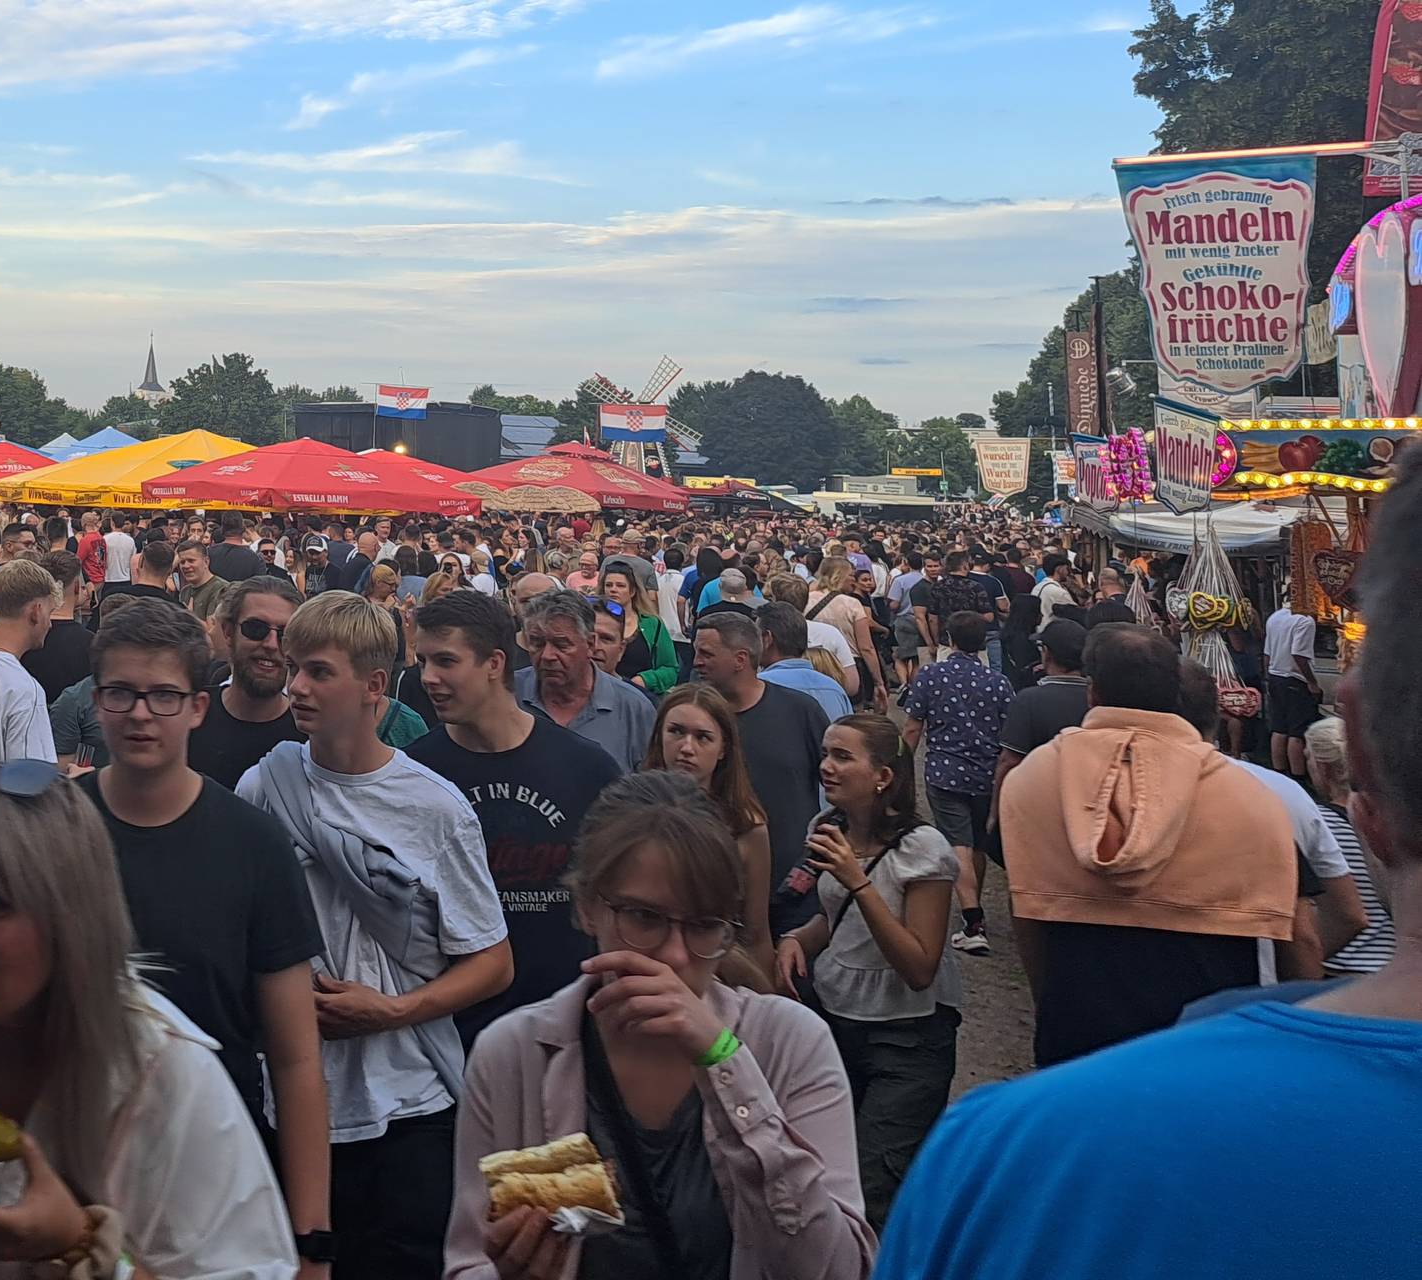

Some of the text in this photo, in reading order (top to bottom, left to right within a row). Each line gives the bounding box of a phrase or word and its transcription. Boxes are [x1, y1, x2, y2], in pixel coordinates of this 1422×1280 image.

[1163, 189, 1273, 209] Frisch gebrannte
[1146, 207, 1296, 245] Mandeln
[1165, 244, 1280, 259] mit wenig Zucker
[1182, 263, 1263, 282] Gekühlte
[1160, 281, 1296, 312] Schoko-
[1167, 313, 1288, 344] früchte
[1170, 343, 1289, 357] in feinster Pralinen-
[1196, 357, 1265, 370] Schokolade
[1157, 426, 1212, 491] Mandeln
[113, 494, 129, 503] Viva
[293, 494, 348, 503] ESTRELLA DAMM
[488, 782, 510, 799] IN
[515, 785, 566, 828] BLUE
[498, 891, 570, 903] EANSMAKER
[509, 903, 548, 912] VINTAGE
